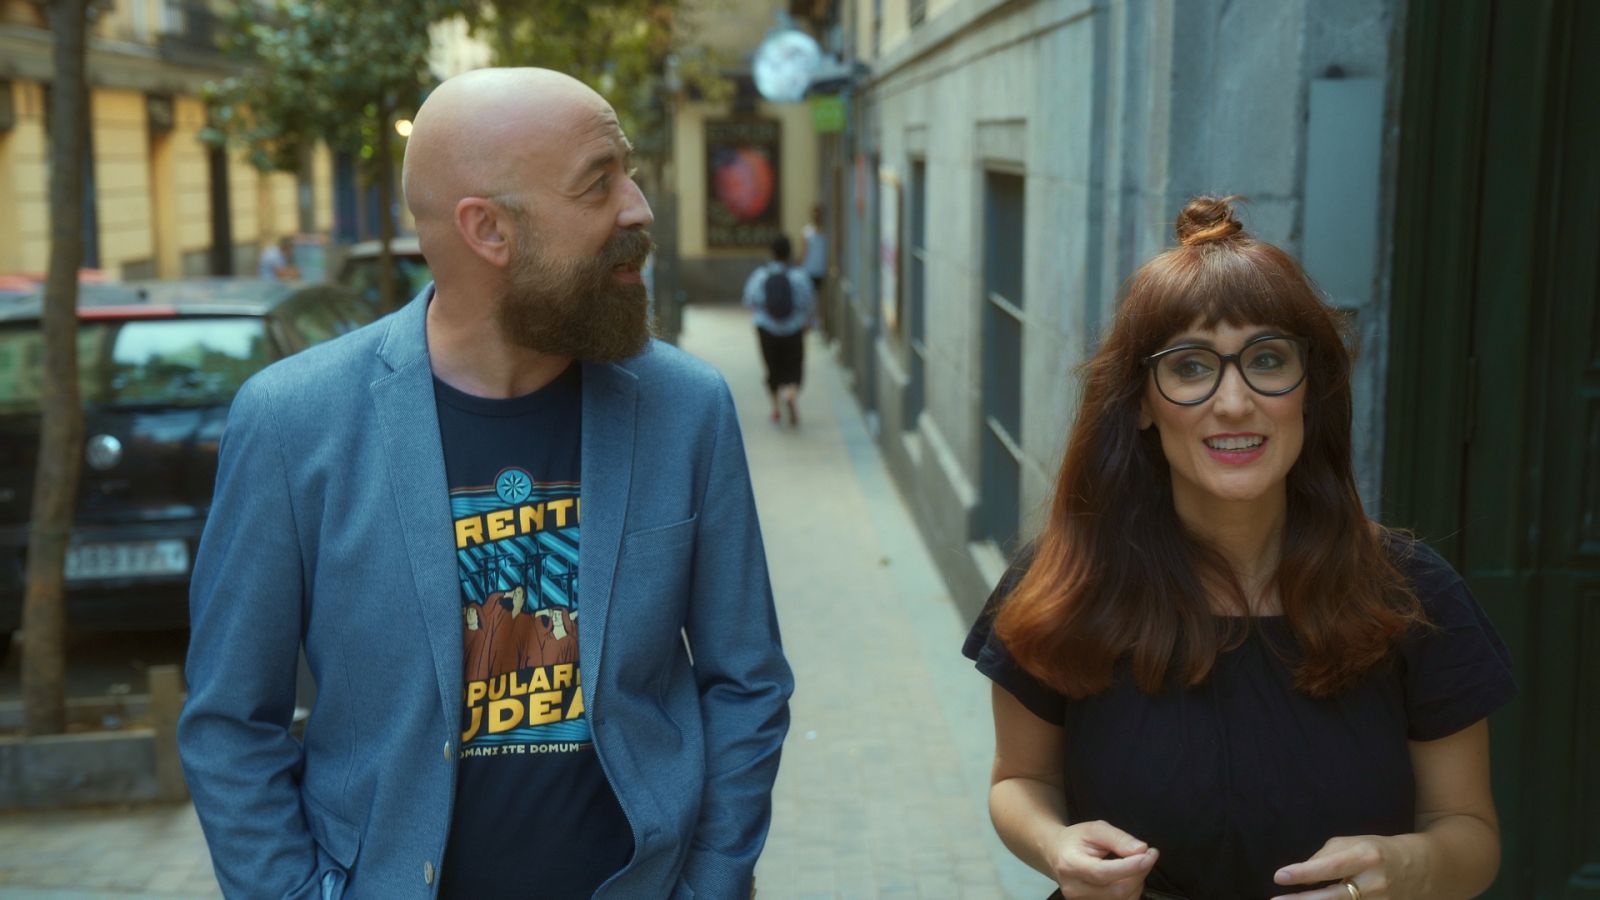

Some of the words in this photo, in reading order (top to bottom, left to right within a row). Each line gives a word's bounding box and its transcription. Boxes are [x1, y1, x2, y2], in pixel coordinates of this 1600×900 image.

[455, 497, 580, 549] RENT
[464, 663, 580, 708] PULAR
[501, 744, 526, 755] ITE
[530, 743, 579, 754] DOMUM
